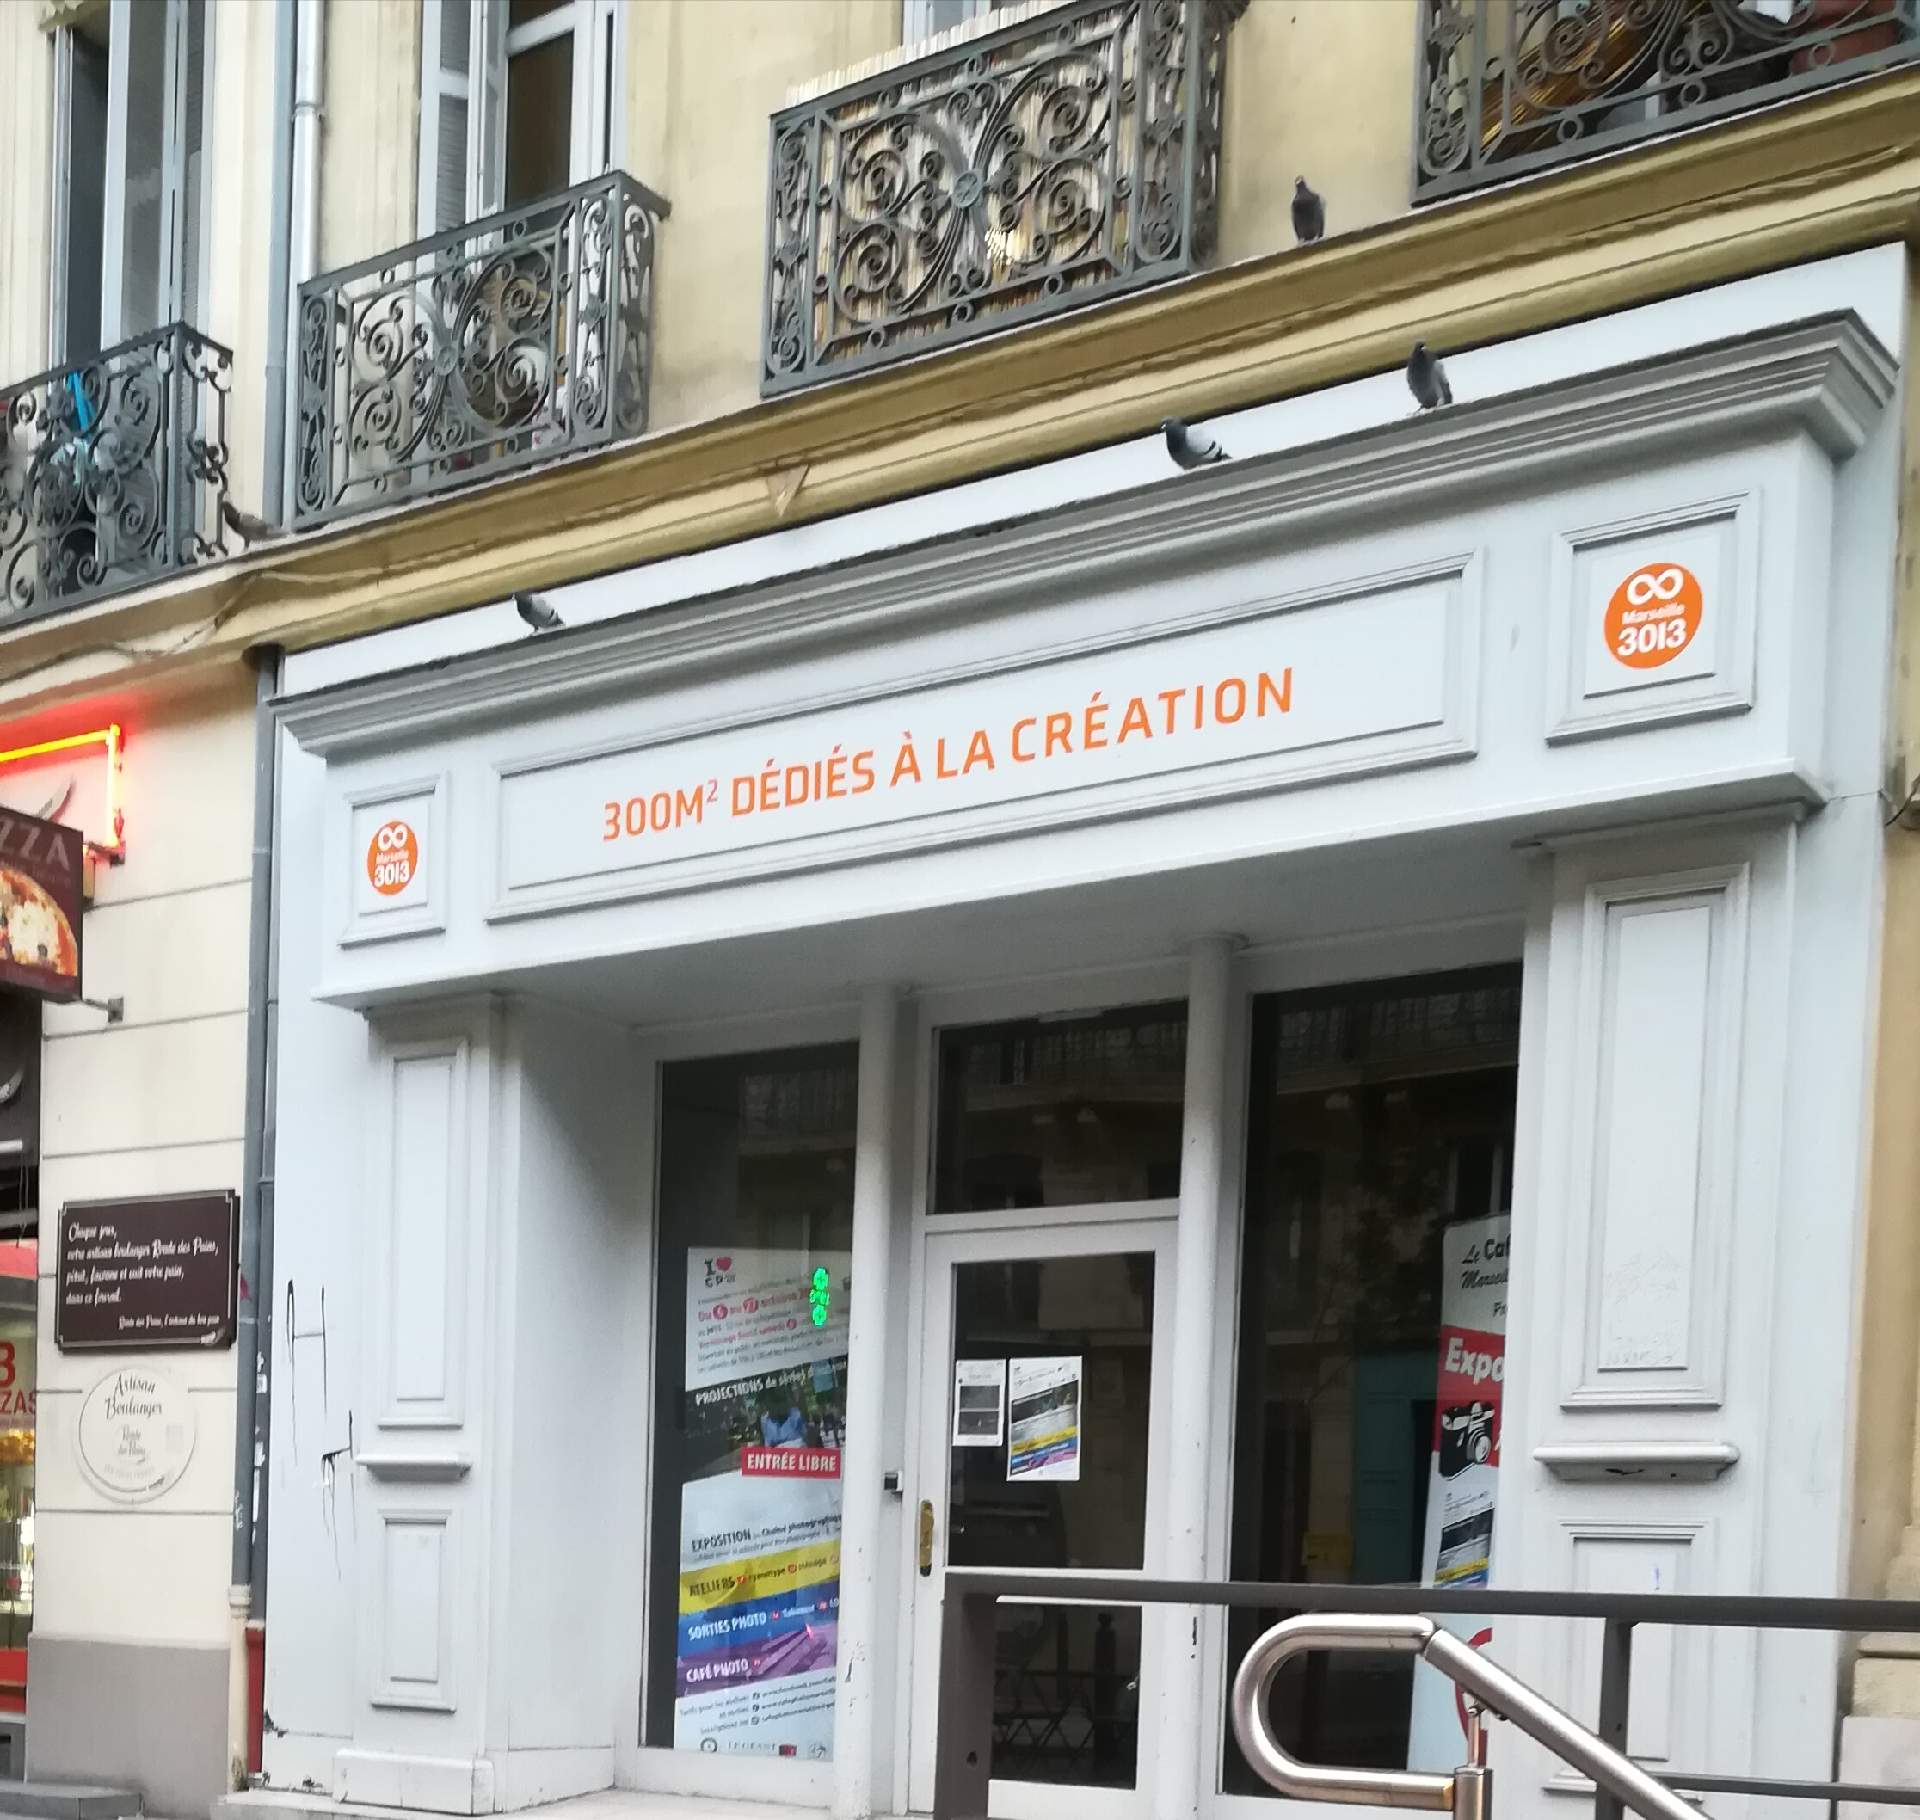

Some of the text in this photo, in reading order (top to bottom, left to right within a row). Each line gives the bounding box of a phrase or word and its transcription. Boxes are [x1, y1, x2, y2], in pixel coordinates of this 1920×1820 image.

[1617, 618, 1687, 656] 3013
[731, 743, 876, 817] DÉDIÉS
[889, 729, 921, 787] À
[936, 728, 995, 779] LA
[1010, 666, 1293, 763] CRÉATION
[374, 860, 410, 888] 3013
[1461, 1243, 1481, 1265] Le
[1445, 1337, 1505, 1386] Expo
[114, 1374, 156, 1397] Artisan
[695, 1379, 764, 1406] PROJECTIONS
[105, 1396, 162, 1420] Boulanger
[747, 1452, 837, 1472] ENTRÉE LIBRE
[691, 1528, 752, 1551] EXPOSITION
[689, 1576, 736, 1597] ATELIERS
[688, 1612, 767, 1641] SORTIES PHOTO
[686, 1658, 749, 1683] CAFÉ PHOTO
